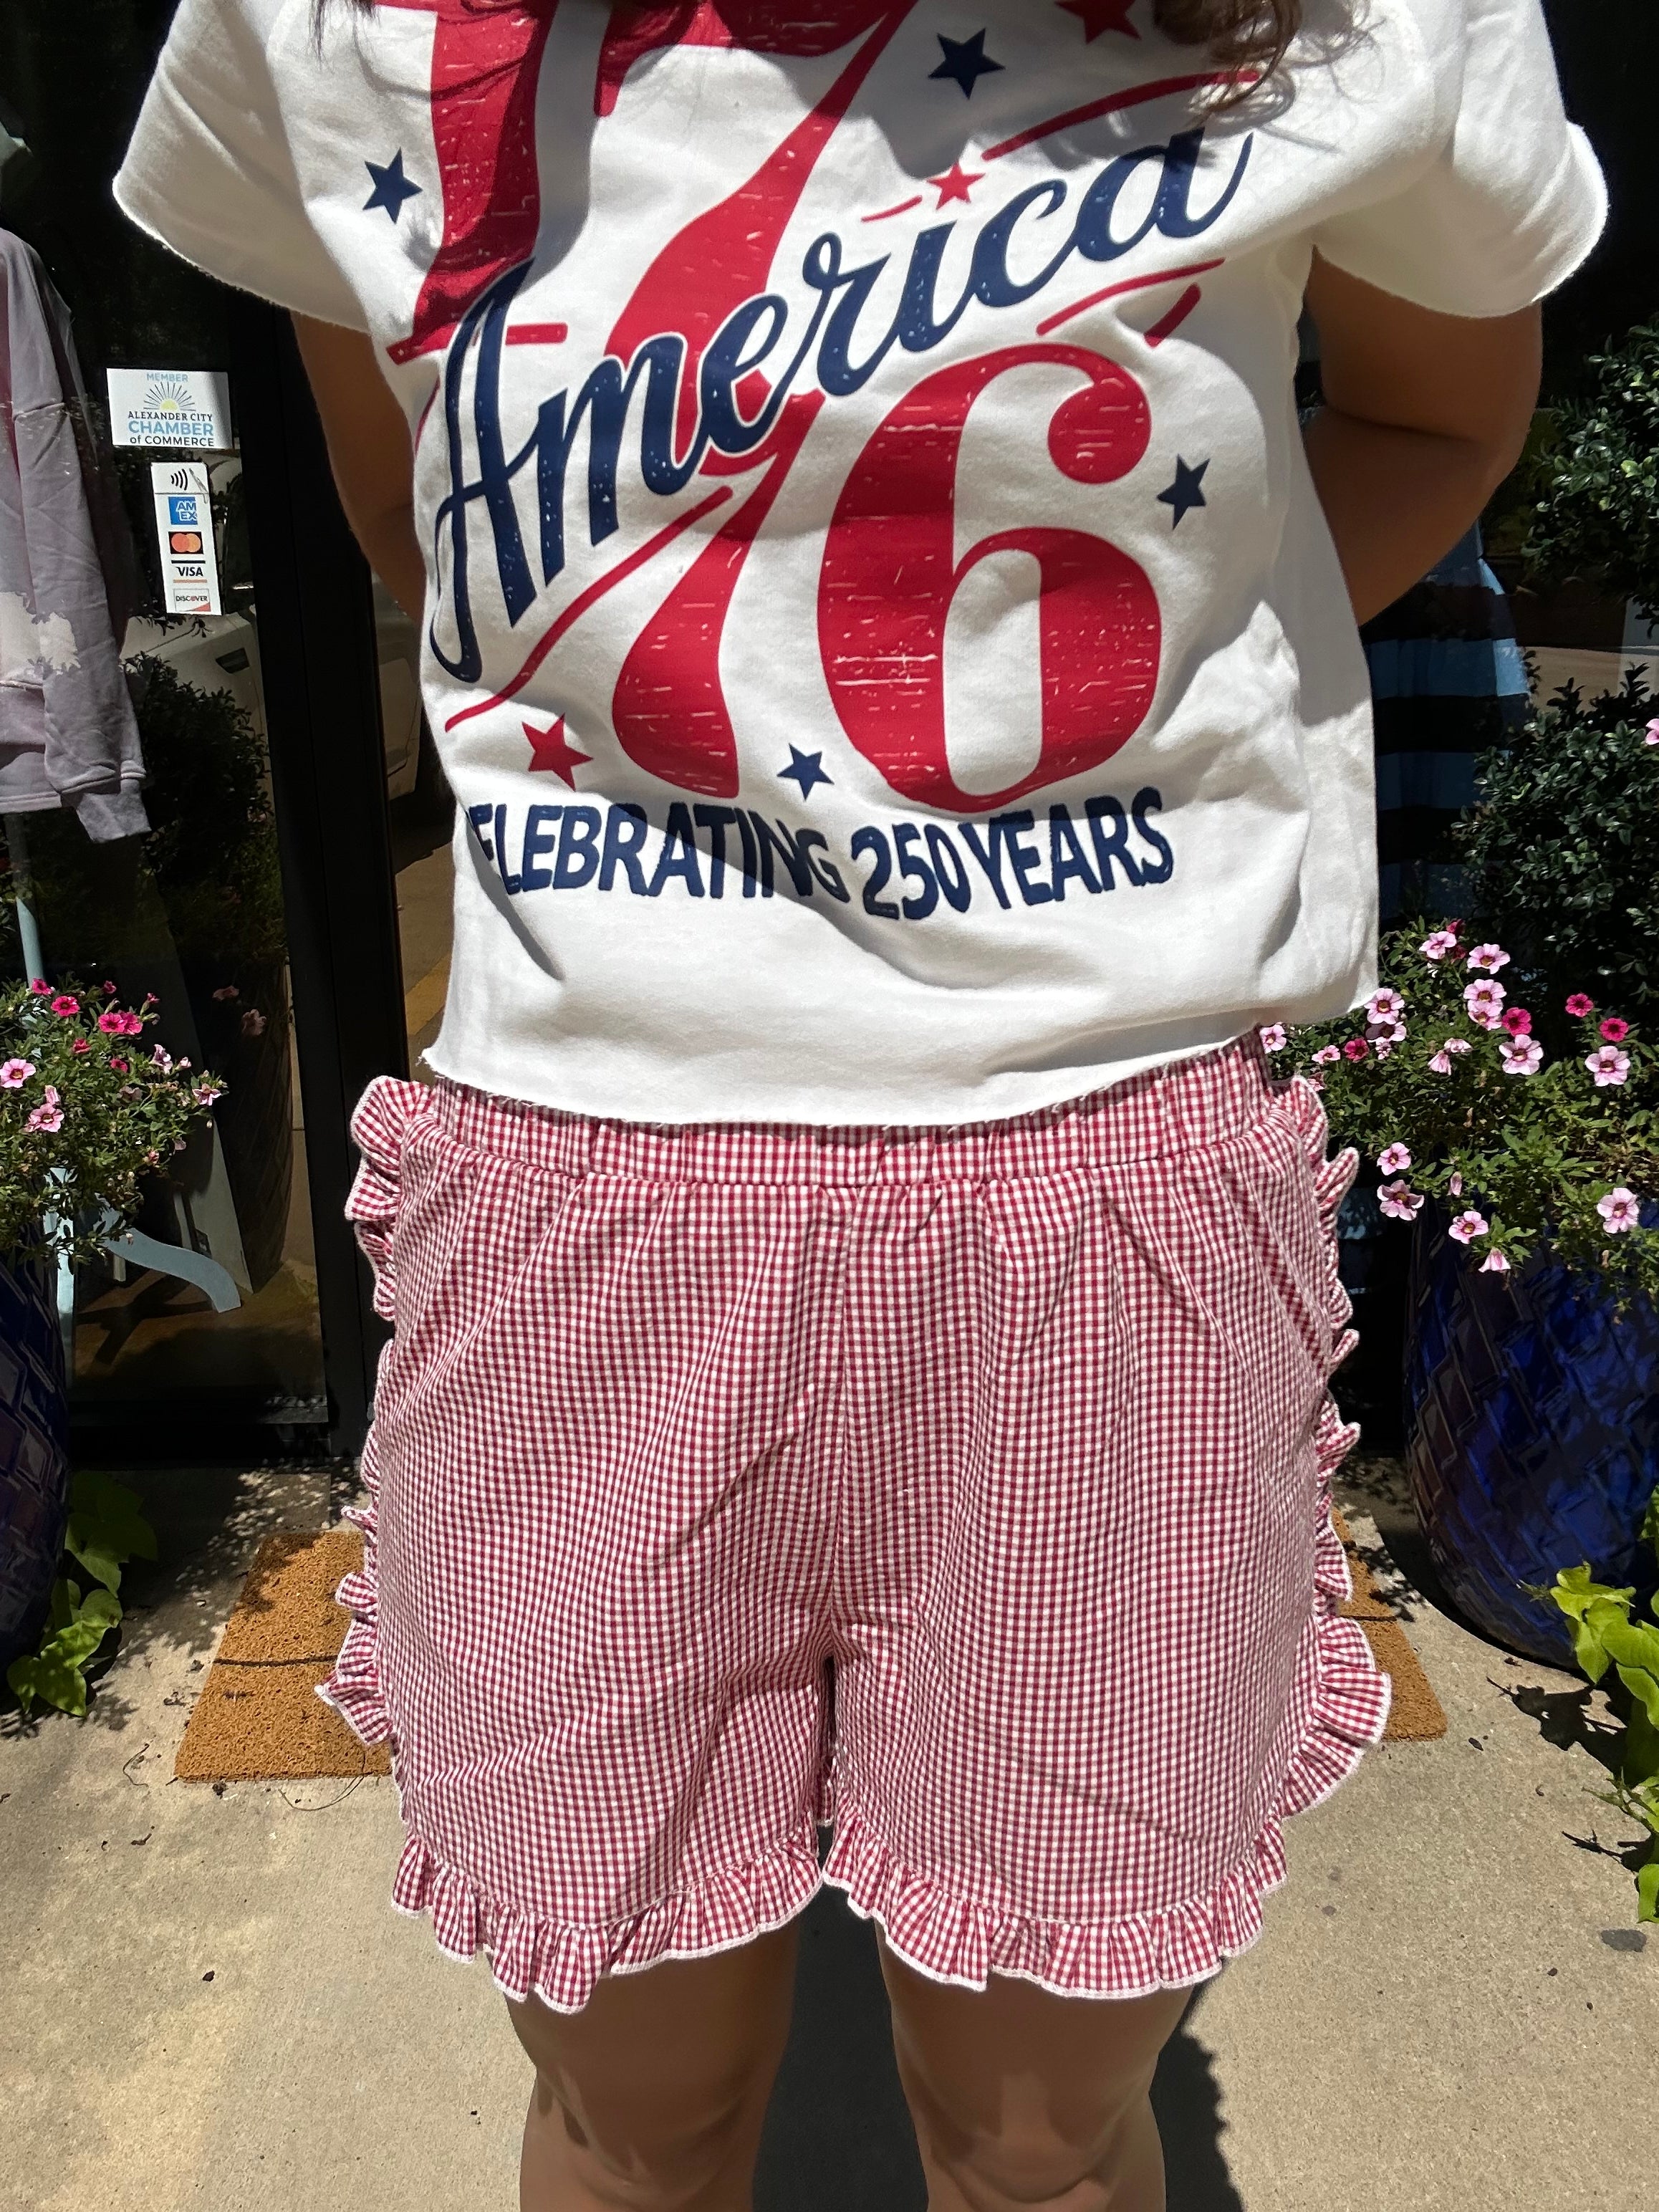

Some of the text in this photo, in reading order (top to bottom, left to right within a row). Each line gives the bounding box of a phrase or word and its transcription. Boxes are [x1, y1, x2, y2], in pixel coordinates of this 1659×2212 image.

[147, 372, 188, 382] MEMBER
[430, 126, 1255, 683] America
[128, 411, 213, 422] ALEXANDER CITY
[128, 420, 213, 436] CHAMBER
[130, 435, 215, 447] of COMMERCE
[175, 501, 197, 511] AM
[179, 511, 198, 521] EX
[175, 566, 204, 577] VISA
[853, 822, 971, 920] 250
[960, 788, 1174, 910] YEARS
